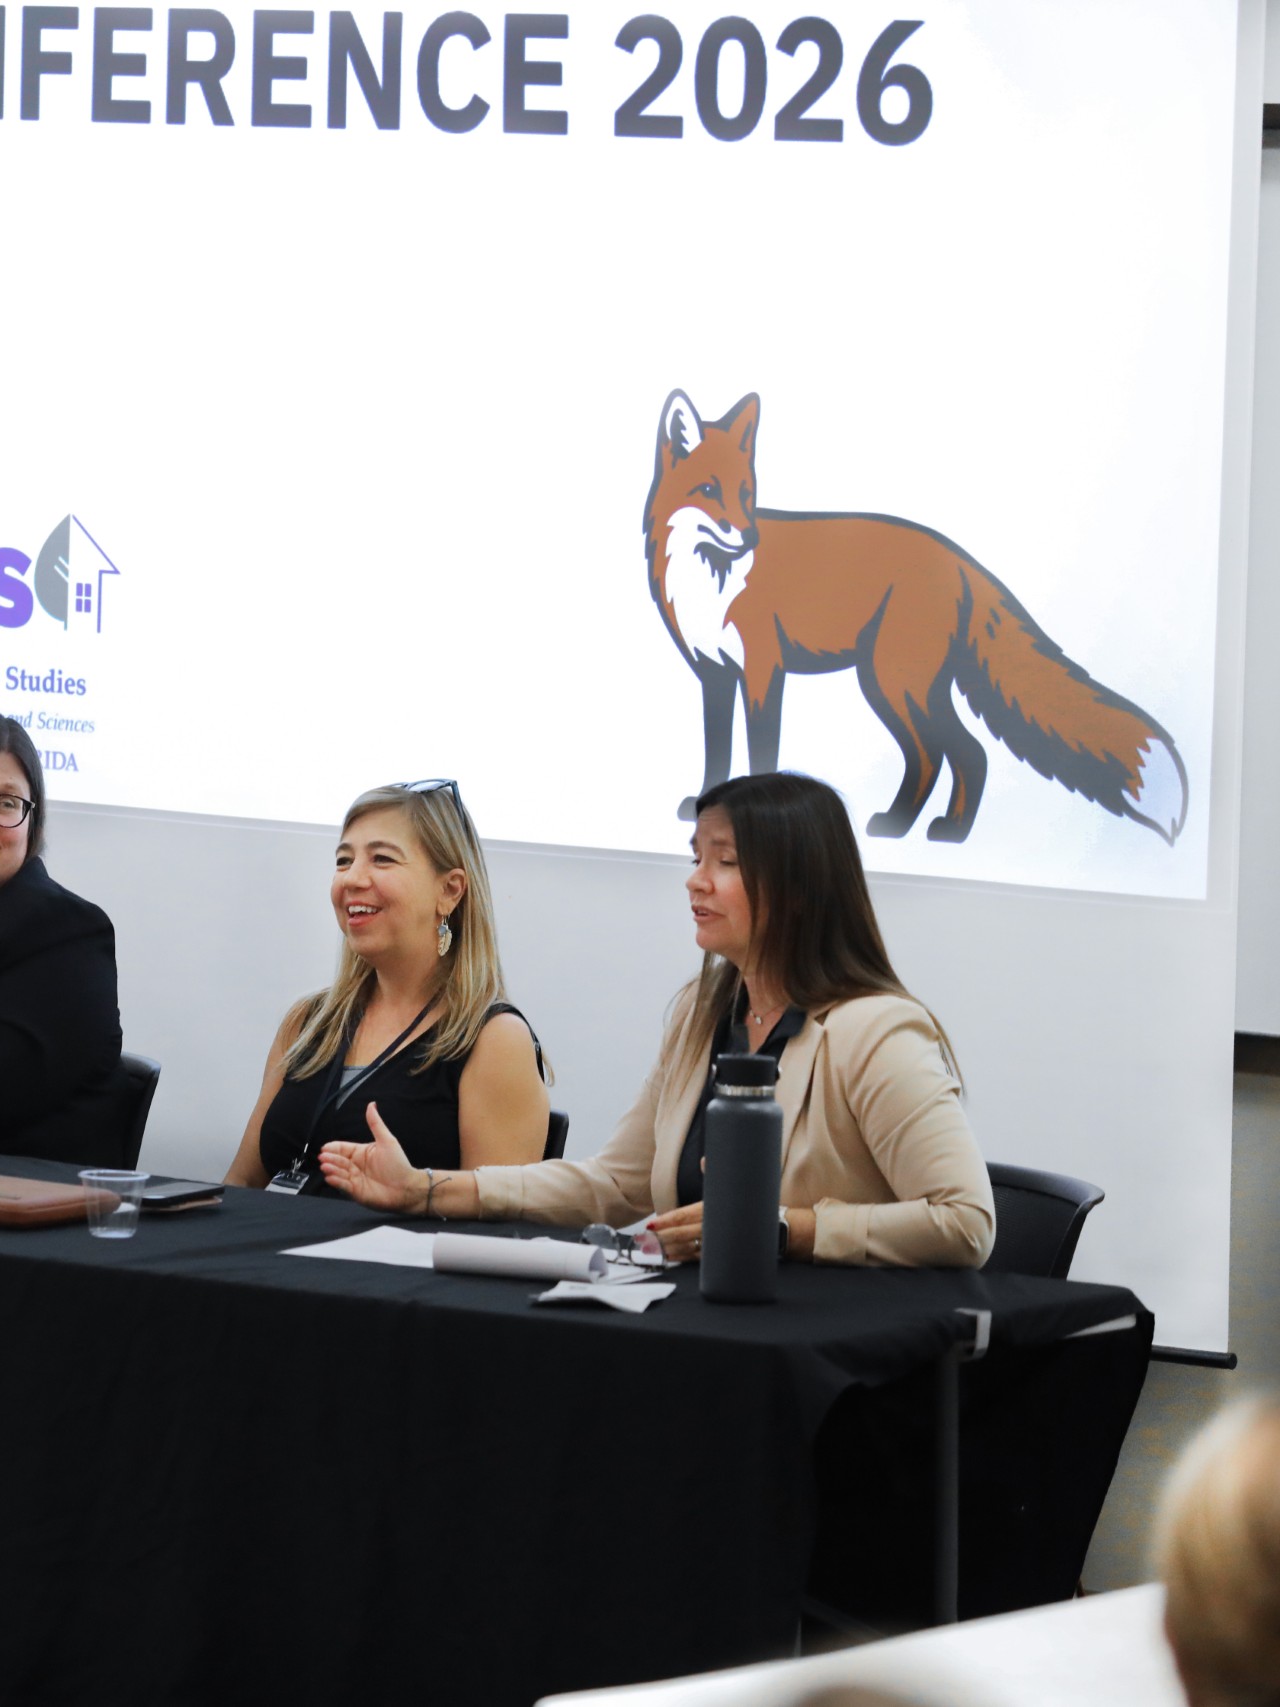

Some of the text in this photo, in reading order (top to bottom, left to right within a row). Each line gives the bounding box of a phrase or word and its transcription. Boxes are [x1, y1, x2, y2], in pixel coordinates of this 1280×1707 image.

[613, 14, 934, 147] 2026
[5, 665, 87, 697] Studies
[37, 711, 95, 733] Sciences
